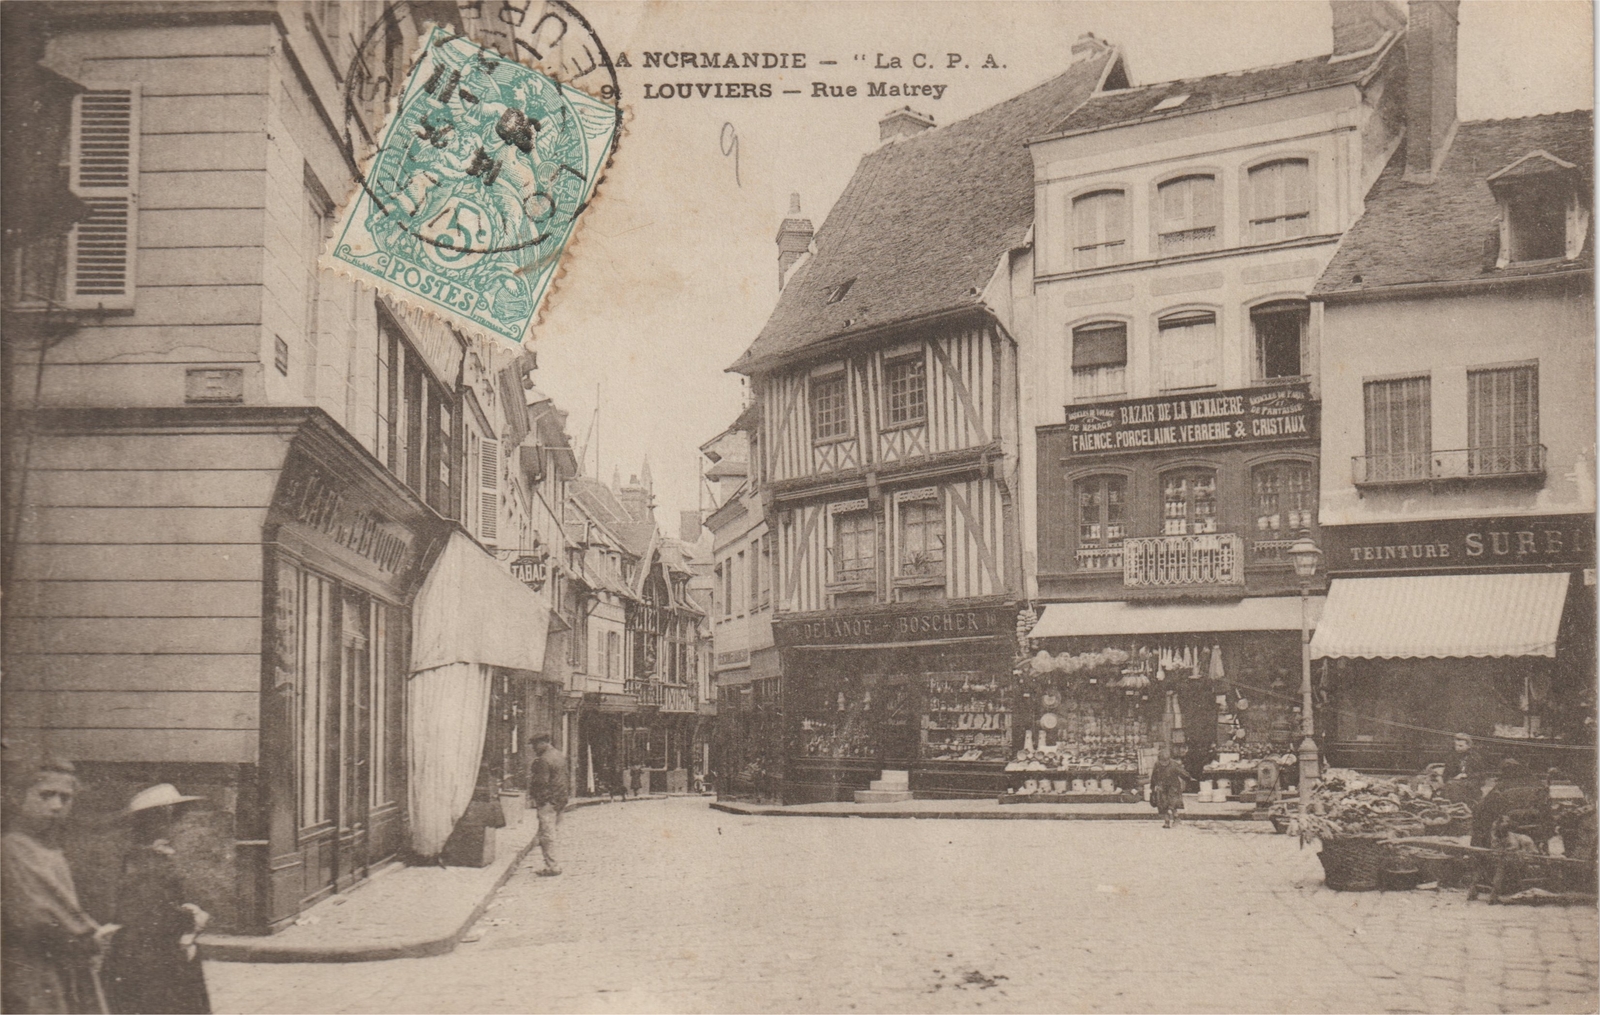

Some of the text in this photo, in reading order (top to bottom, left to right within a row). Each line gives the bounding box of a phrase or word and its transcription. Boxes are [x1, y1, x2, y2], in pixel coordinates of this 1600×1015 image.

[388, 257, 475, 312] POSTES
[1120, 403, 1155, 425] BAZAR
[1157, 402, 1171, 422] DE
[1173, 401, 1188, 420] LA
[1234, 420, 1247, 438] &
[1252, 415, 1306, 437] CRISTAUX
[1350, 543, 1450, 561] TEINTURE
[511, 563, 546, 582] TABAC
[899, 612, 979, 635] BOSCHER
